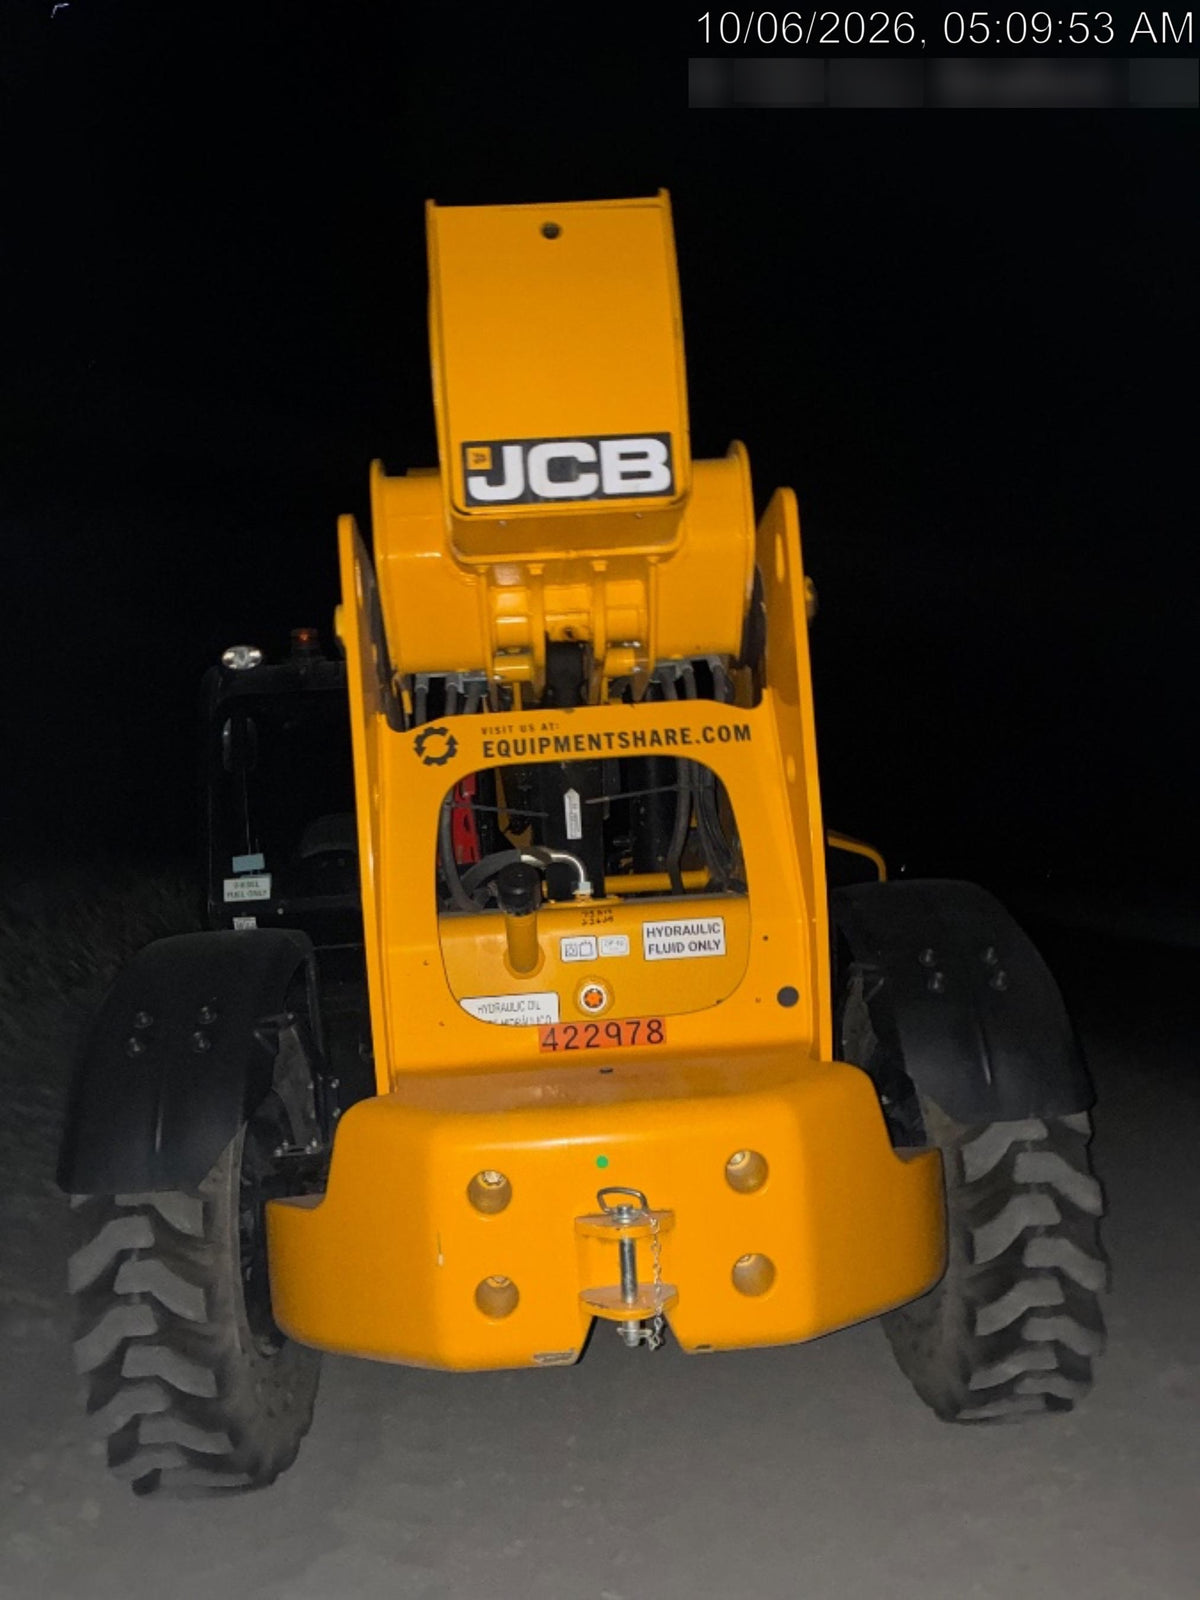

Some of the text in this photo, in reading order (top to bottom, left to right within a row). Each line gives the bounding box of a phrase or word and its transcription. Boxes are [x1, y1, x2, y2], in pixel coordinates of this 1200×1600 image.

[467, 438, 671, 501] JCB
[481, 722, 559, 736] VISIT US AT:
[483, 724, 752, 758] EQUIPMENTSHARE.COM
[646, 922, 721, 939] HYDRAULIC
[648, 939, 721, 956] FLUID ONLY
[478, 1000, 525, 1014] HYDRAULIC
[542, 1019, 664, 1052] 422978
